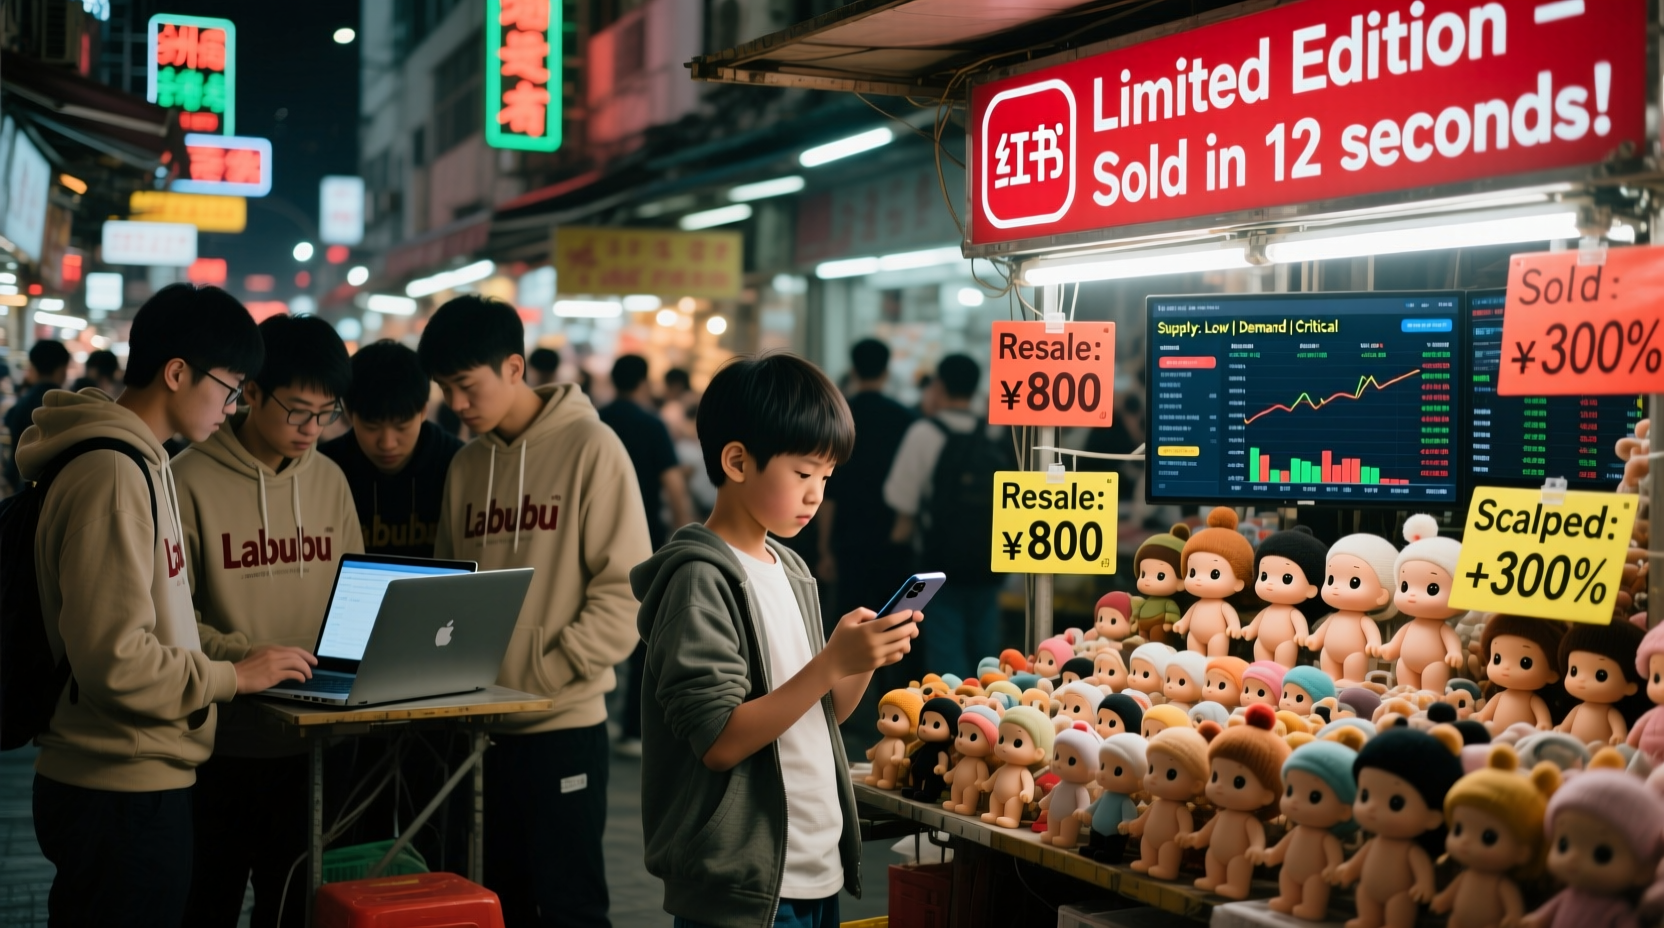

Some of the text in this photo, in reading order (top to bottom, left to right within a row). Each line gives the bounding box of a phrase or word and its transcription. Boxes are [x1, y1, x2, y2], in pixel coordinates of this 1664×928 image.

[1094, 37, 1269, 132] Limited
[1293, 1, 1506, 94] Edition
[995, 123, 1063, 188] 红书
[1093, 63, 1611, 206] Sold in 12 seconds!
[1519, 265, 1620, 306] Sold:
[1000, 332, 1102, 361] Resale:
[1157, 320, 1202, 338] Supply:
[1204, 320, 1230, 334] Low
[1239, 318, 1287, 334] Demand
[1295, 318, 1339, 334] Critical
[1511, 319, 1662, 375] ¥300%
[1000, 371, 1101, 413] ¥800
[464, 494, 559, 539] Labubu
[1002, 481, 1104, 511] Resale:
[1002, 520, 1103, 562] ¥800
[1474, 498, 1618, 544] Scalped:
[221, 526, 332, 570] Labubu
[1465, 550, 1607, 605] +300%
